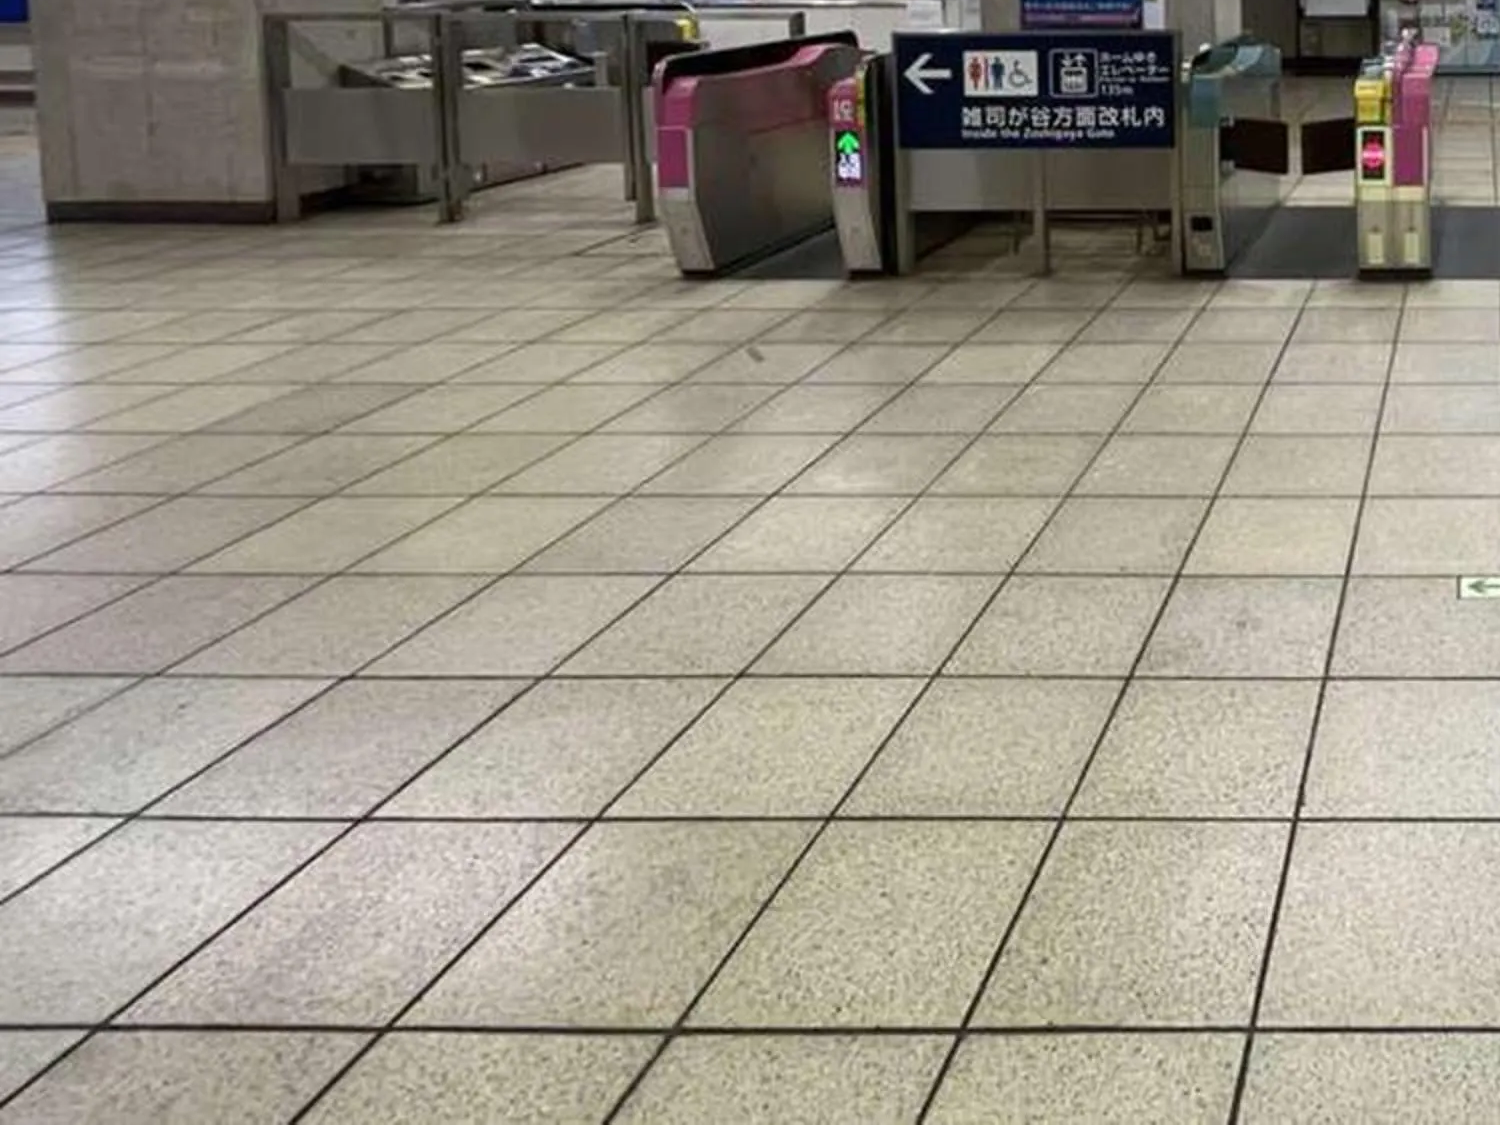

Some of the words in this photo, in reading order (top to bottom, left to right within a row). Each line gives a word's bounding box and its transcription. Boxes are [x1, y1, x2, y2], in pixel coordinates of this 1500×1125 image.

[961, 105, 1165, 128] 雑司が谷方面改札内
